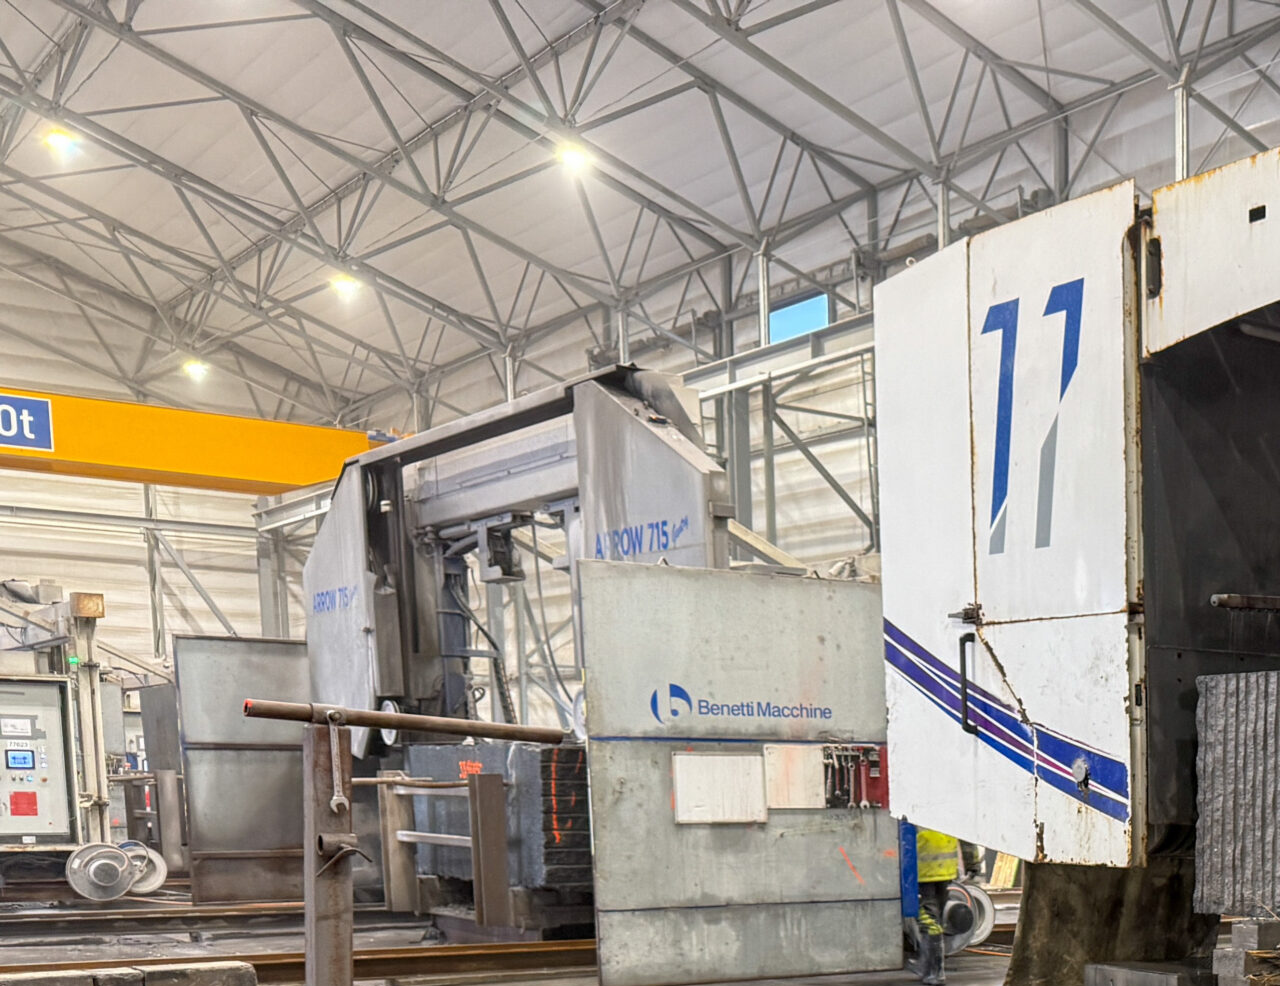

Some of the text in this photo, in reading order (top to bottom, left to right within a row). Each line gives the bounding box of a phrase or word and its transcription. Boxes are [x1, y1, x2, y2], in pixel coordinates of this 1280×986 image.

[648, 520, 669, 552] 715
[698, 699, 832, 720] Benetti Macchine
